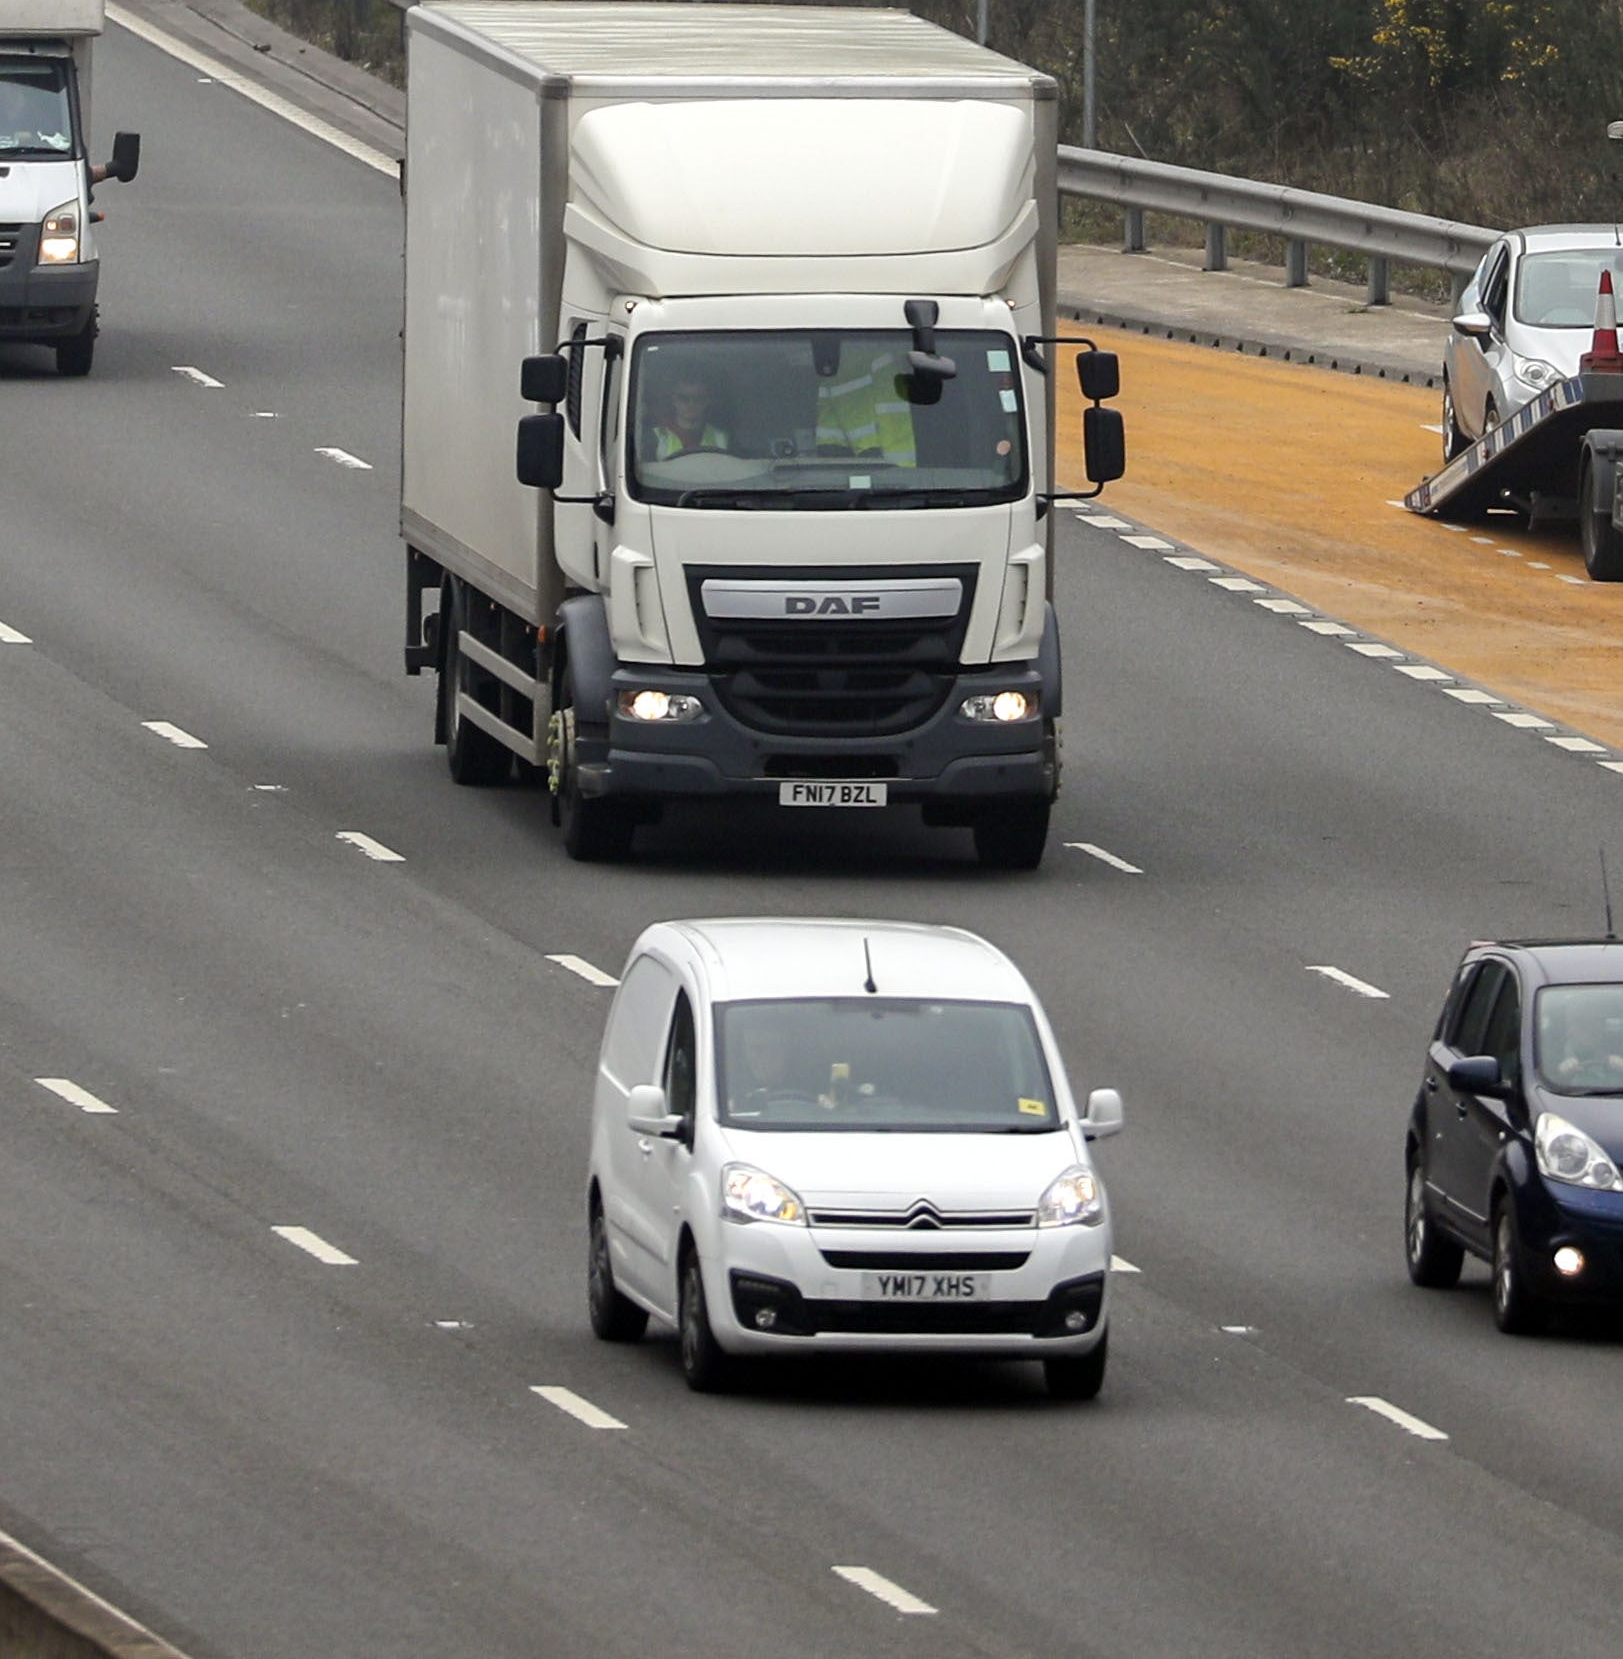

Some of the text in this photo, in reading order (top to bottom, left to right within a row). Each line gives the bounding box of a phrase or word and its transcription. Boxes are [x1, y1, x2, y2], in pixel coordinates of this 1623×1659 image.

[784, 596, 880, 614] DAF
[792, 784, 878, 804] FN17 BZL
[878, 1275, 975, 1297] YM17 XHS
